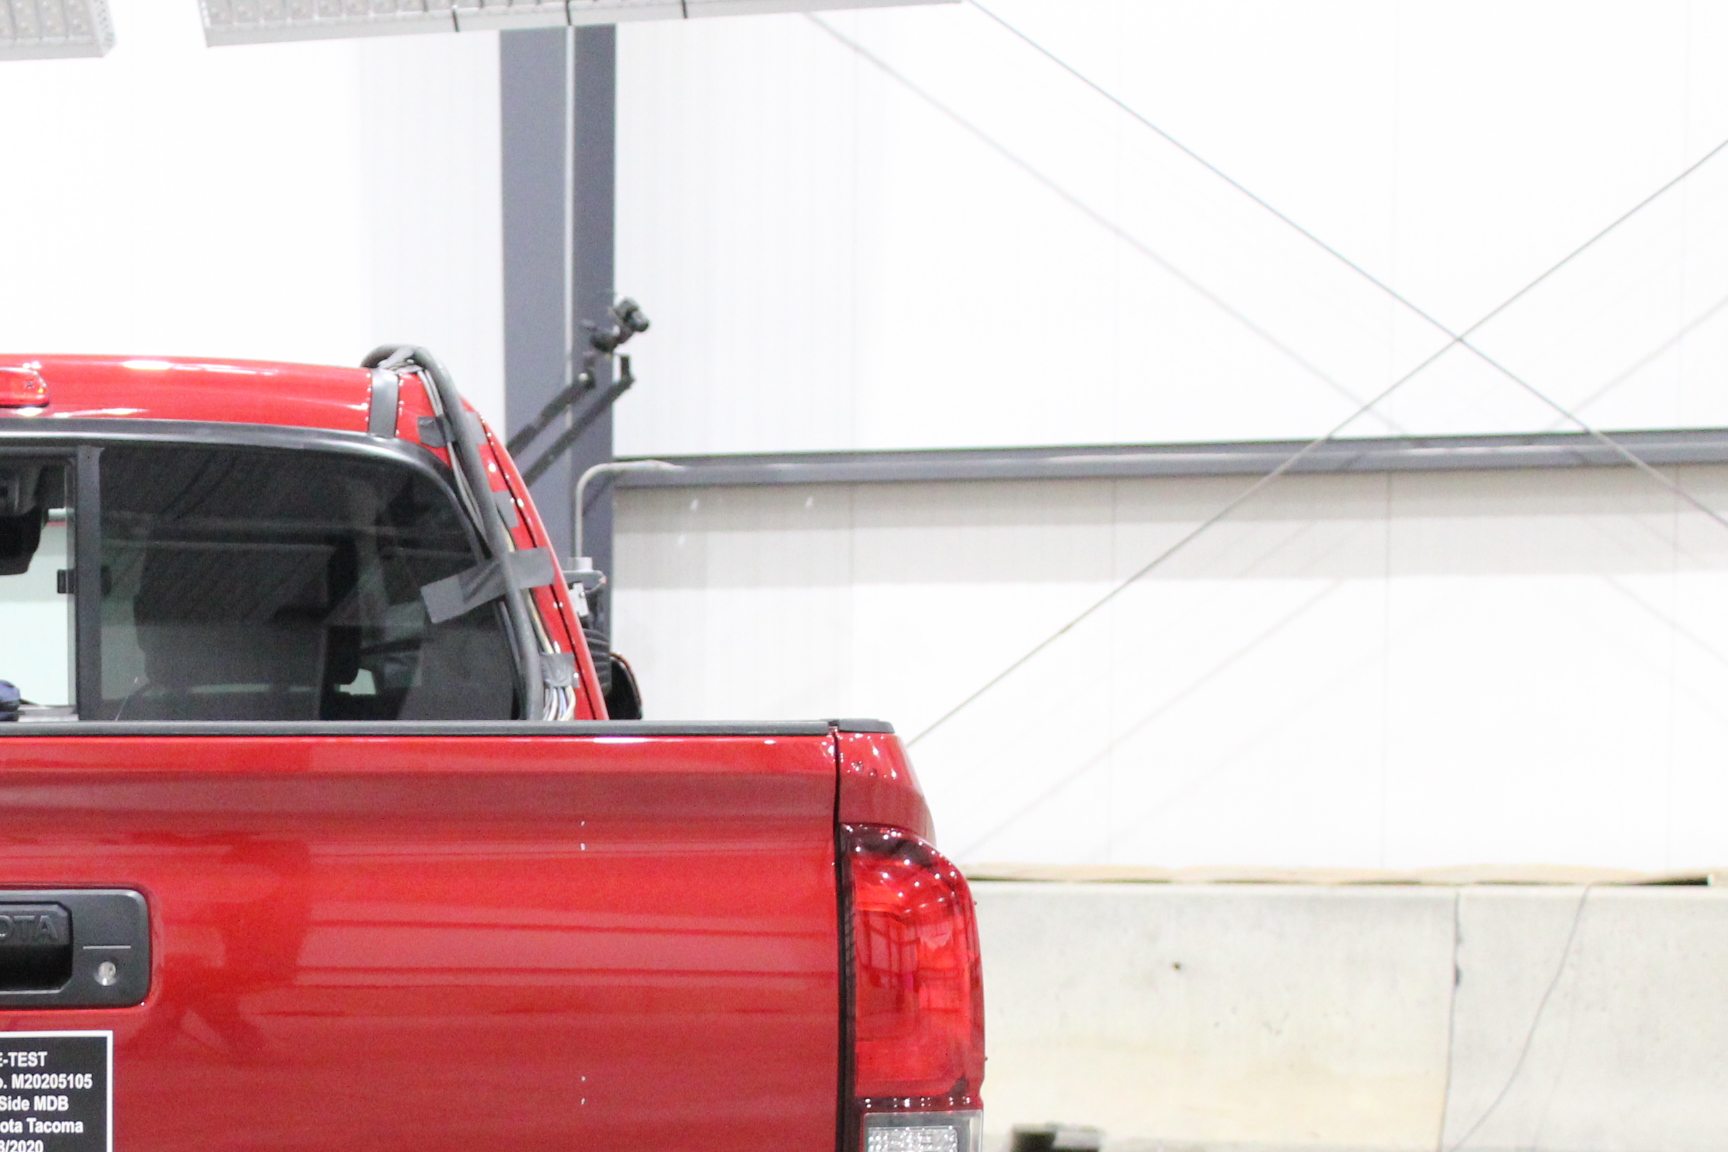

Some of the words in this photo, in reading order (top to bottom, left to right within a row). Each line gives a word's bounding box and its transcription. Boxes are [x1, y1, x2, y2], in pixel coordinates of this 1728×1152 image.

[11, 1074, 92, 1089] M20205105
[34, 1096, 69, 1111] MDB
[26, 1117, 83, 1133] Tacoma
